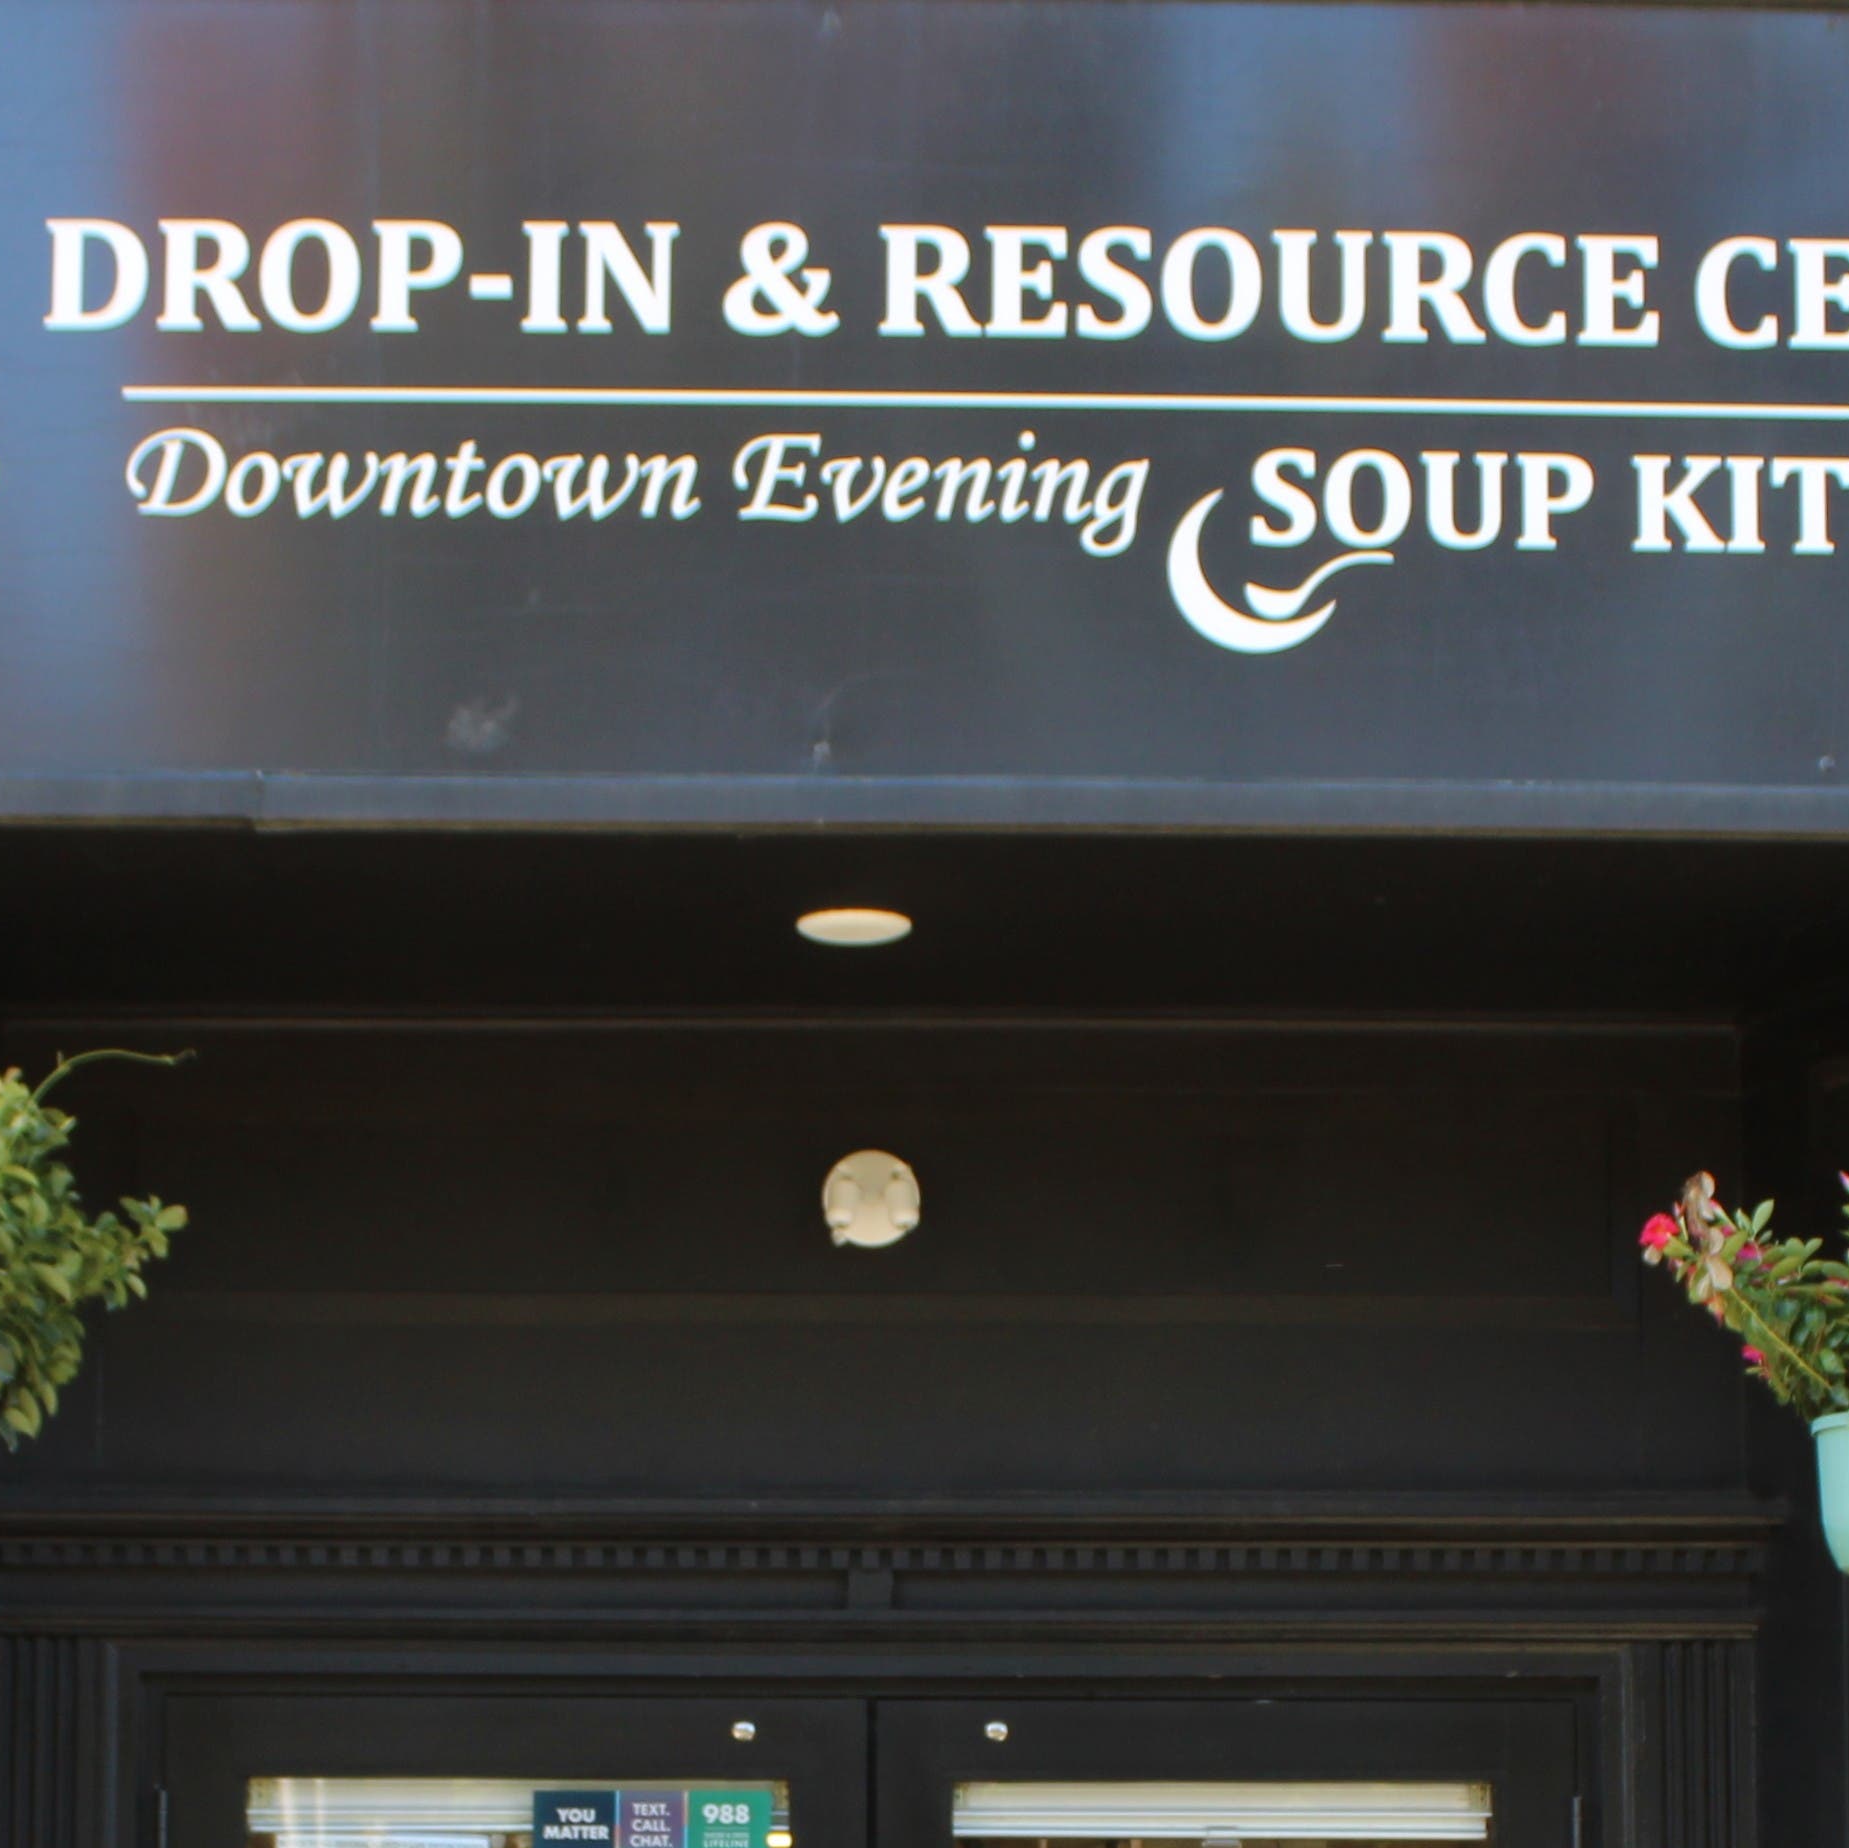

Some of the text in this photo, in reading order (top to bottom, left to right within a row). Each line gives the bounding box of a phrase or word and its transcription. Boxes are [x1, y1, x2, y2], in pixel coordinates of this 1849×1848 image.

[42, 218, 679, 332] DROP-IN
[723, 222, 839, 335] &
[879, 226, 1660, 346] RESOURCE
[125, 428, 700, 520] Downtown
[733, 432, 1150, 557] Evening
[1250, 448, 1593, 552] SOUP
[557, 1808, 596, 1823] YOU
[633, 1803, 670, 1816] TEXT.
[703, 1803, 750, 1824] 988
[544, 1825, 609, 1840] MATTER
[632, 1819, 670, 1832] CALL.
[630, 1835, 672, 1848] CHAT.
[704, 1839, 750, 1848] LIFELINE
